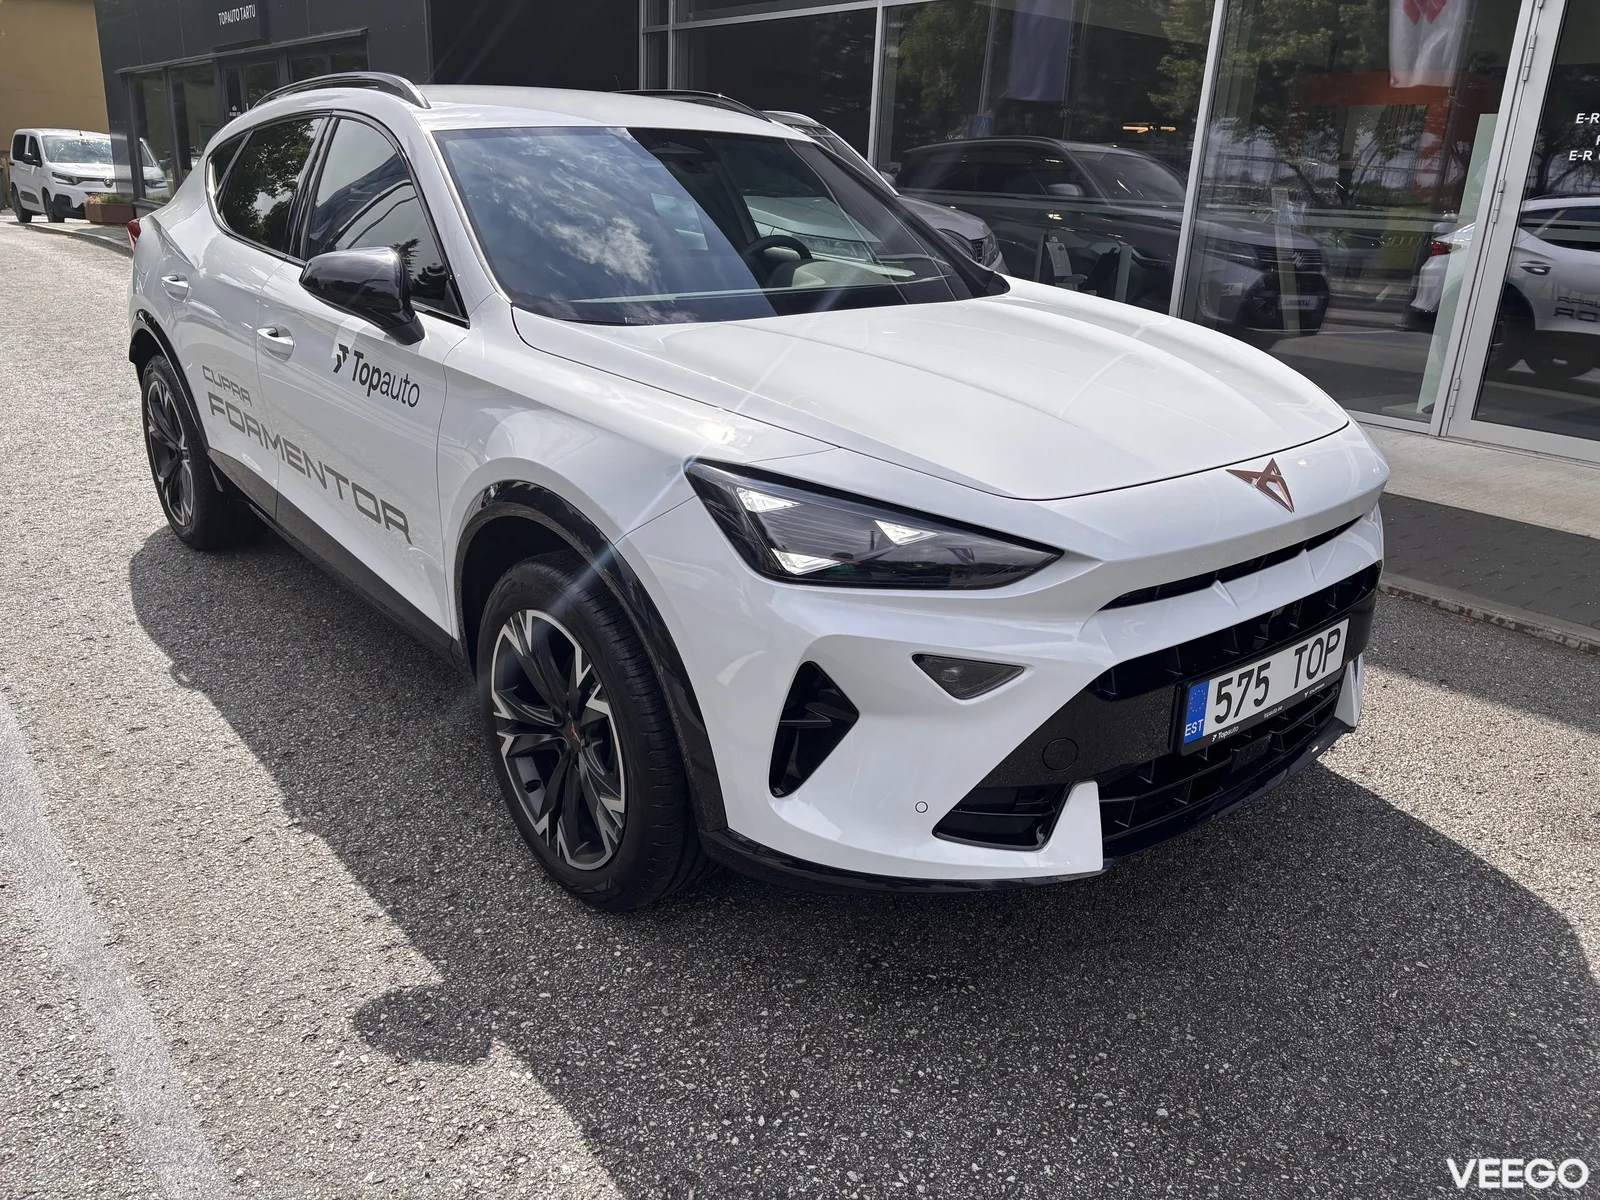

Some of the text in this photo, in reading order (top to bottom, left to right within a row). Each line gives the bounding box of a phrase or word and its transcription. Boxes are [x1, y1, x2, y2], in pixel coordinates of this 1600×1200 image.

[218, 4, 256, 25] TOPAUTO TARTU
[1568, 150, 1593, 161] E-R
[202, 365, 253, 407] CUPRA
[352, 350, 420, 408] Topauto
[207, 391, 413, 546] FORMENTOR
[1214, 627, 1341, 724] 575 TOP
[1185, 719, 1204, 737] EST
